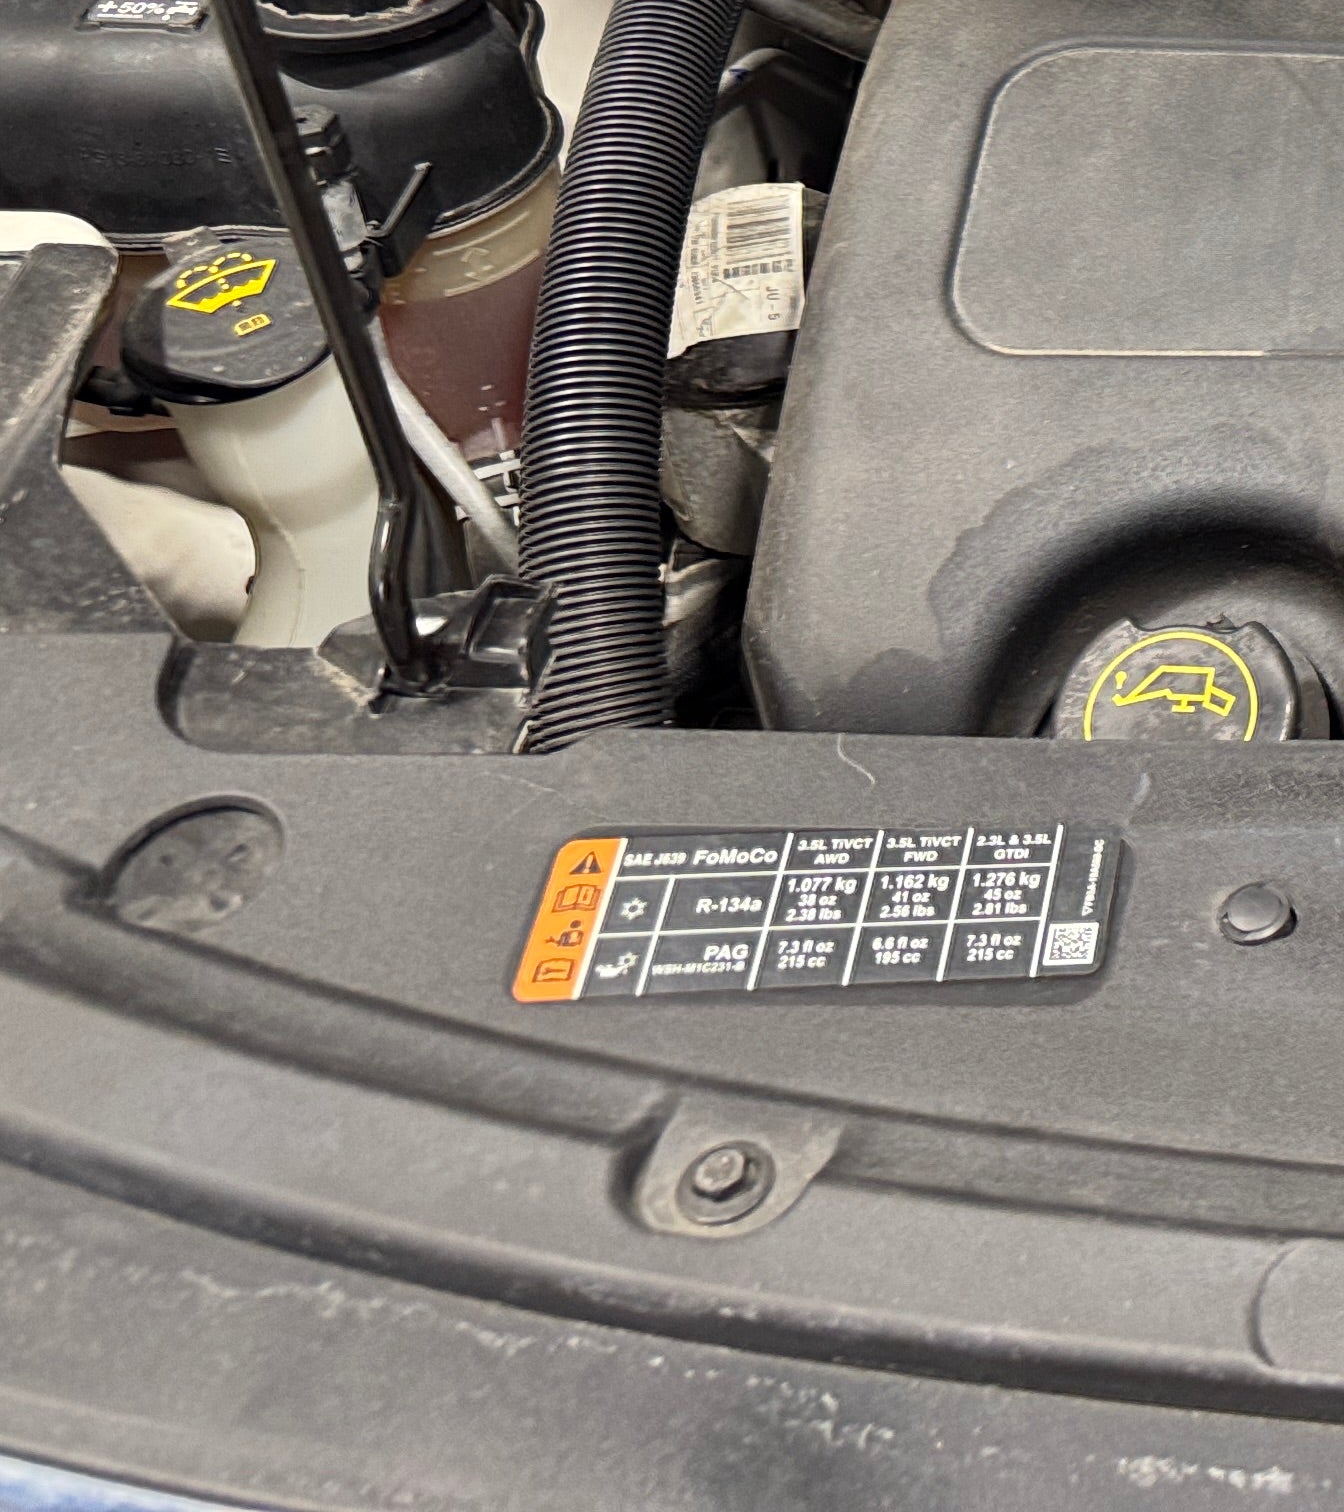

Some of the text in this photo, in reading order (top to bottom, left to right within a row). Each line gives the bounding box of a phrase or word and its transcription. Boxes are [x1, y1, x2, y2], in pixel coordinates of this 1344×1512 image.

[798, 839, 827, 851] 3.5L
[886, 838, 916, 849] 3.5L
[976, 833, 1052, 847] 2.3L & 3.5L
[623, 853, 652, 866] SAE
[693, 848, 778, 866] FoMoCo
[814, 852, 850, 865] AWD
[904, 850, 938, 863] FWD
[788, 876, 857, 894] 1.077 kg
[880, 874, 950, 891] 1.162 kg
[972, 872, 1041, 889] 1.276 kg
[798, 894, 838, 906] 38 oz
[892, 891, 931, 903] 41 oz
[983, 888, 1022, 901] 45 oz
[695, 897, 763, 914] R-134a
[880, 904, 935, 919] 2.56 lbs
[972, 902, 1027, 916] 2.81 lbs
[785, 908, 842, 922] 2.38 lbs
[778, 940, 834, 954] 7.3 fl oz
[872, 936, 929, 951] 6.6 fl oz
[966, 933, 1022, 947] 7.3 fl oz
[704, 943, 749, 960] PAG
[875, 950, 921, 965] 195 cc
[966, 948, 1014, 962] 215 cc
[778, 955, 826, 970] 215 cc
